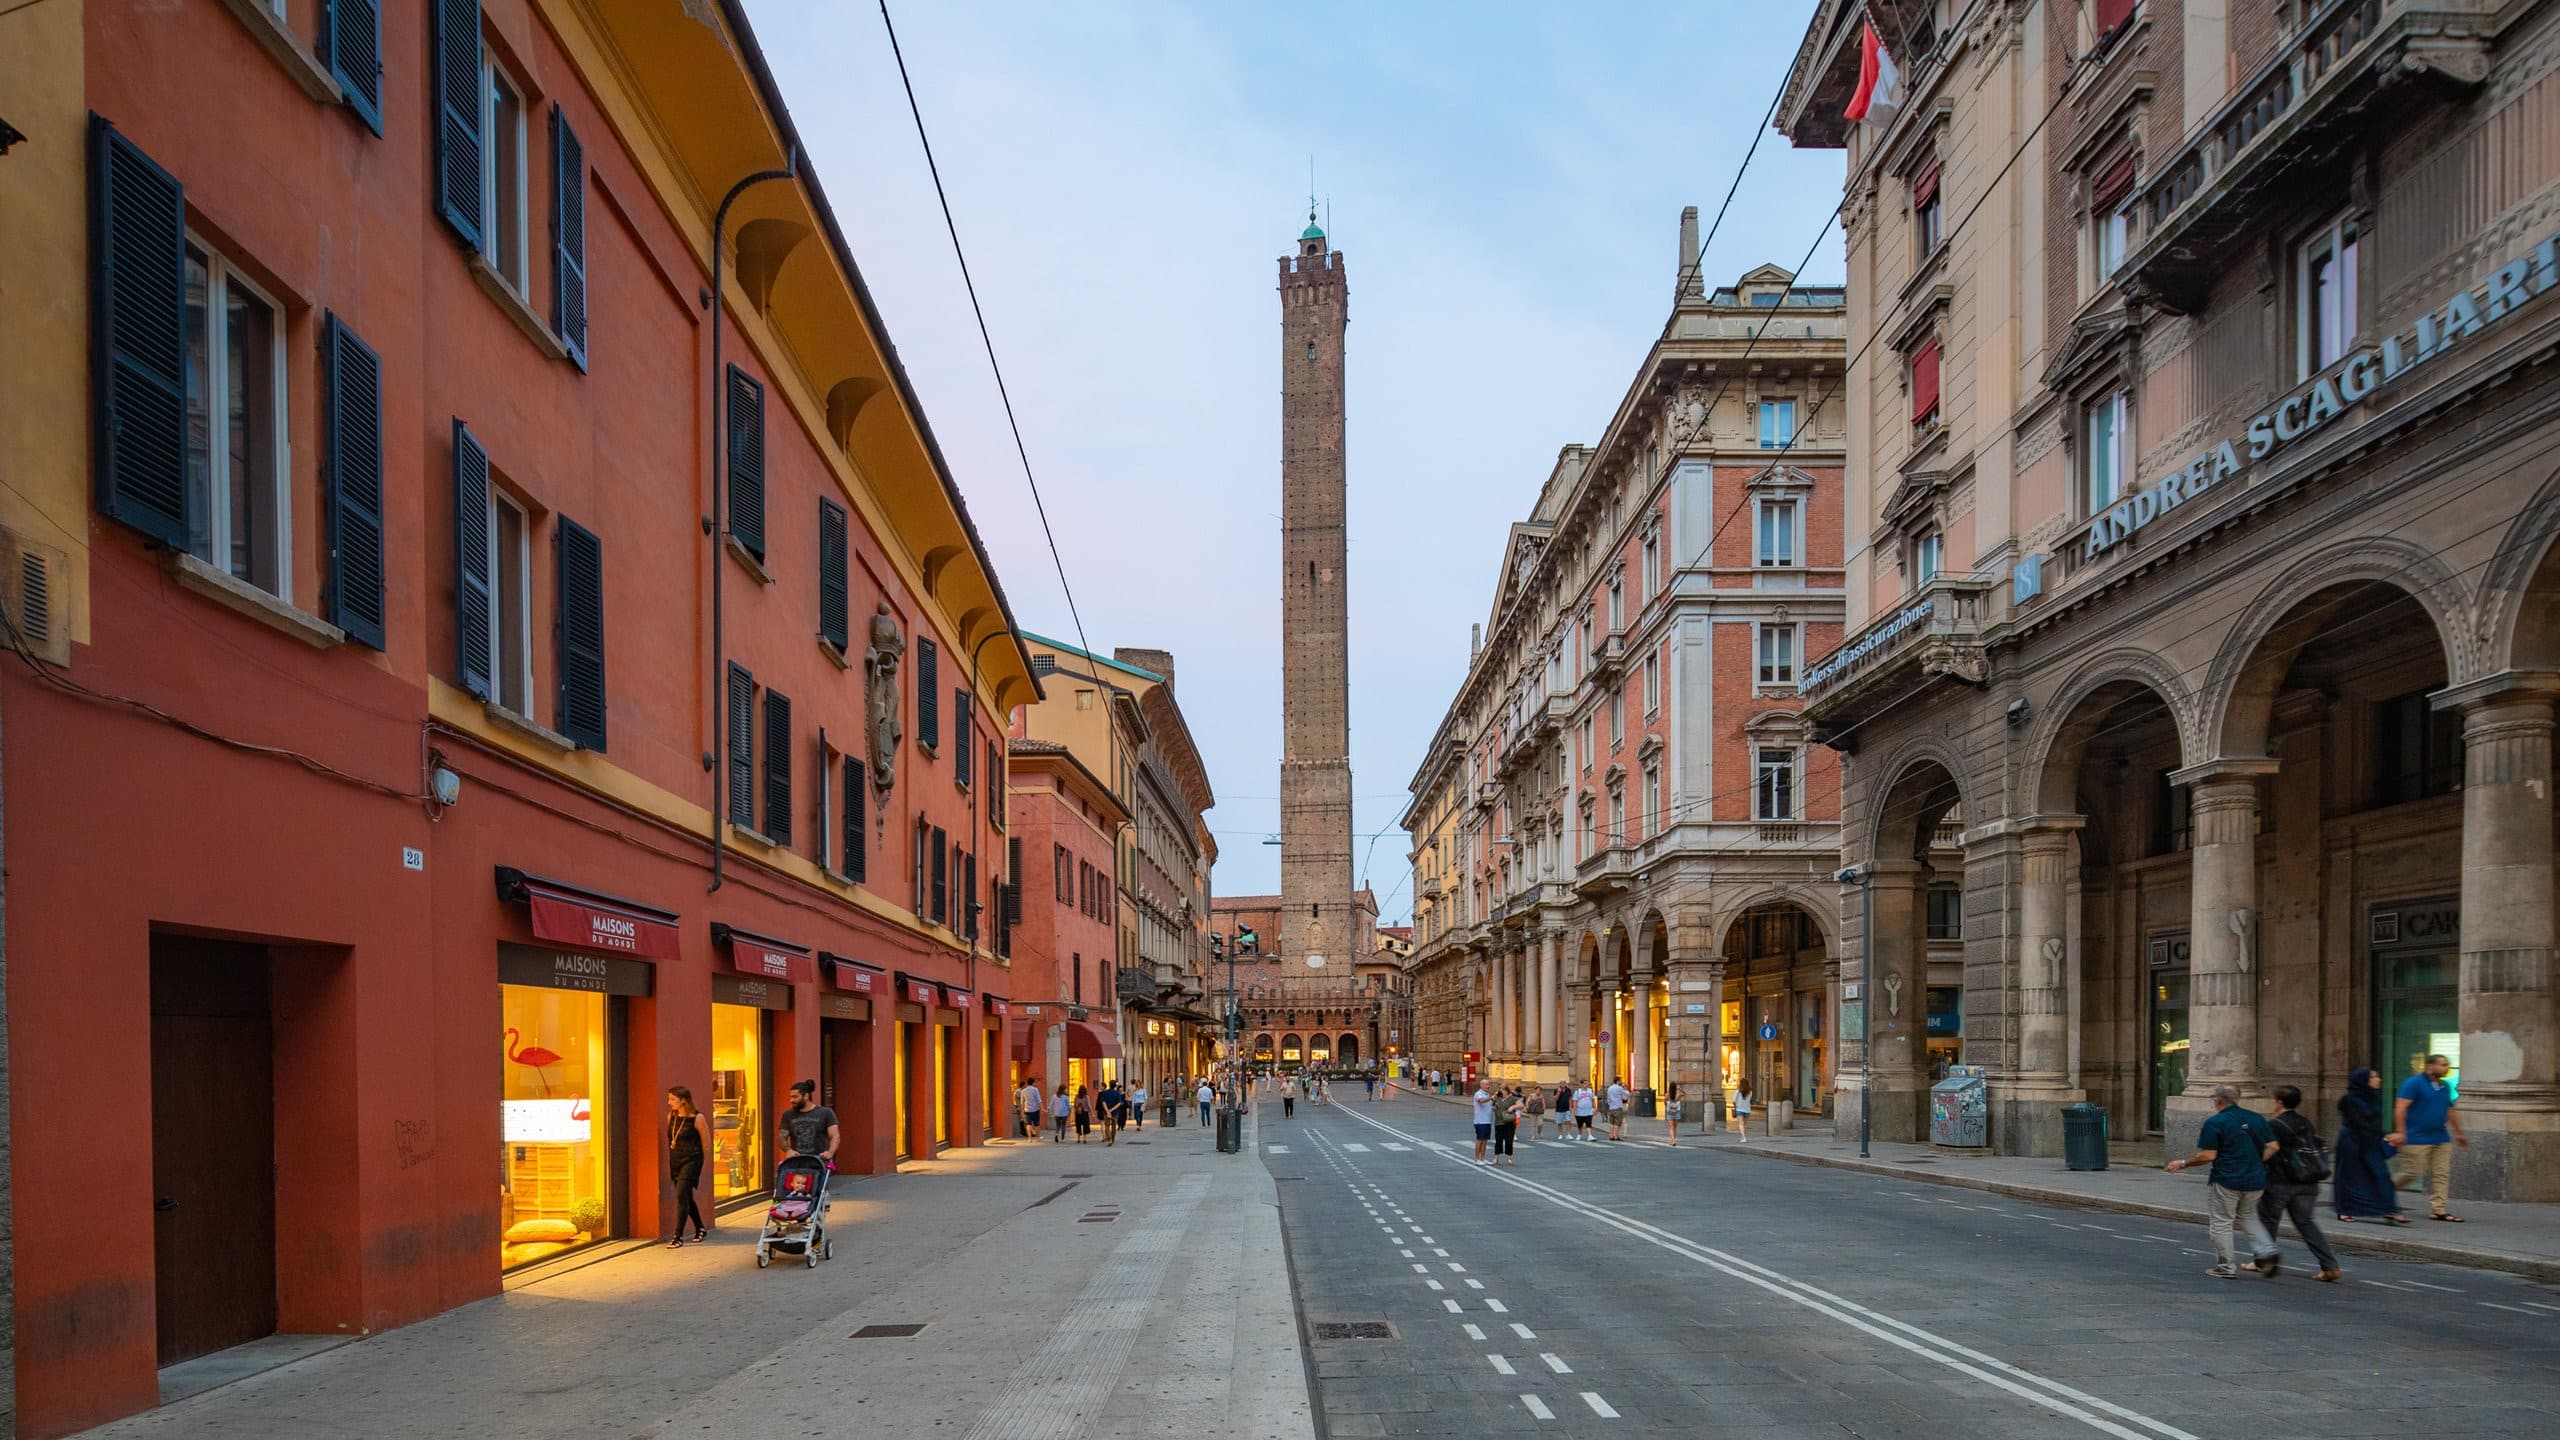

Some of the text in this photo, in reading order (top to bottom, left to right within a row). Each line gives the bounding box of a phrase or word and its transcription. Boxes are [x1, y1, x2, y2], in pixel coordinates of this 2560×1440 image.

[2086, 439, 2242, 558] ANDREA
[1797, 664, 1837, 697] brokers
[407, 850, 420, 866] 28
[593, 915, 635, 937] MAISONS
[592, 934, 636, 949] DU MONDE
[555, 955, 606, 975] MAISONS
[555, 977, 606, 990] DU MONDE
